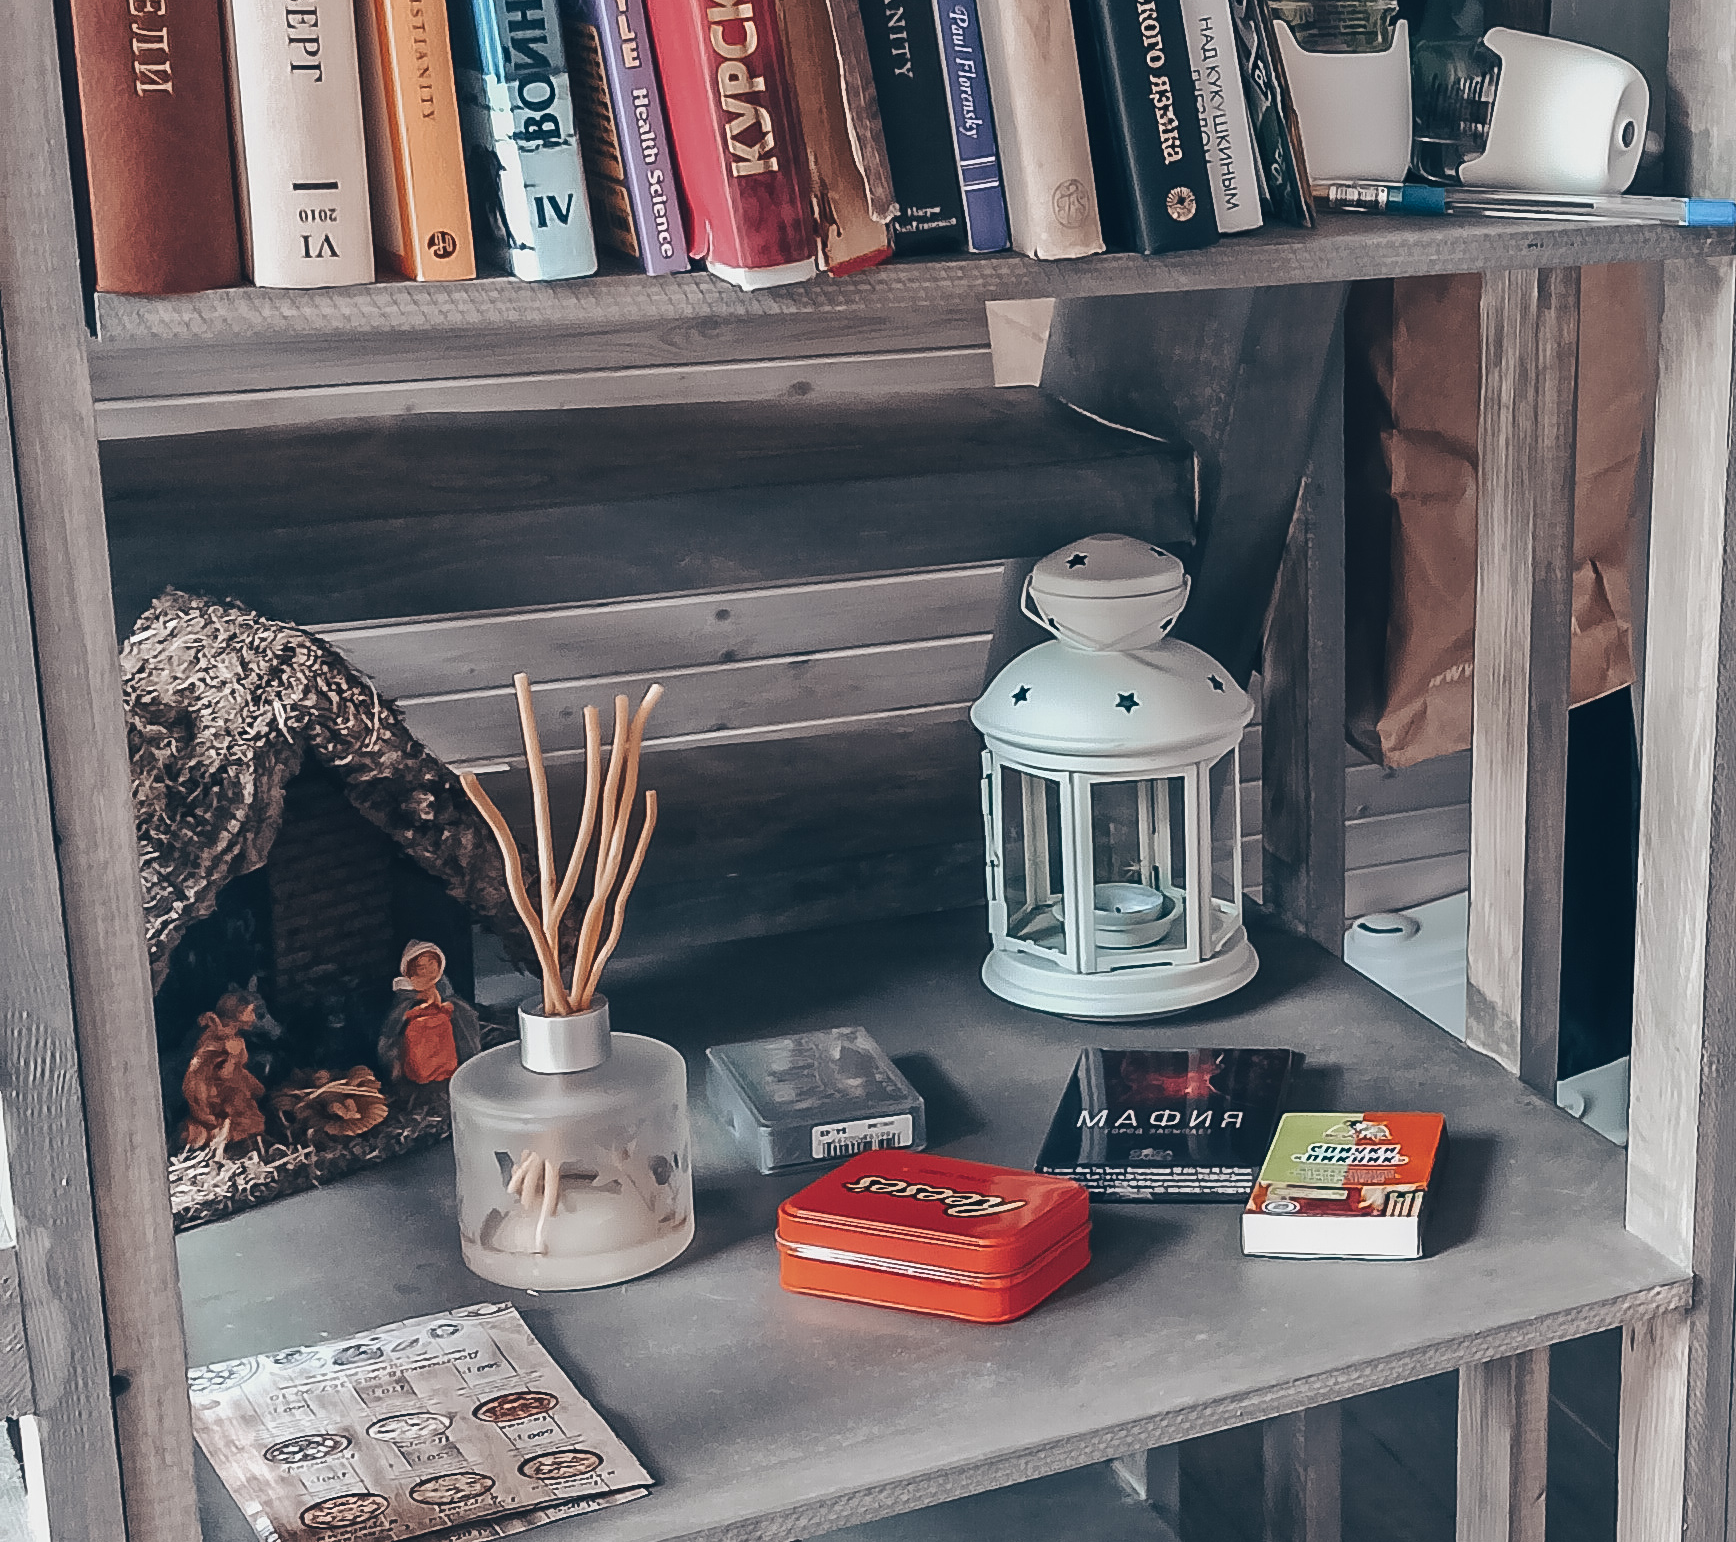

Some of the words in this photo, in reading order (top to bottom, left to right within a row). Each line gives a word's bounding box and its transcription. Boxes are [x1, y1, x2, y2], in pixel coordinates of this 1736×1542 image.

[949, 4, 973, 53] Paul
[1198, 16, 1219, 62] НАД
[956, 55, 984, 139] Florensky
[1149, 74, 1184, 165] языка
[1204, 64, 1240, 211] КУКУШКИНЫМ
[631, 88, 658, 167] Health
[646, 169, 675, 260] Science
[535, 193, 574, 229] IV
[1076, 1108, 1244, 1129] МАФИЯ
[1310, 1144, 1398, 1154] СПИЧКИ
